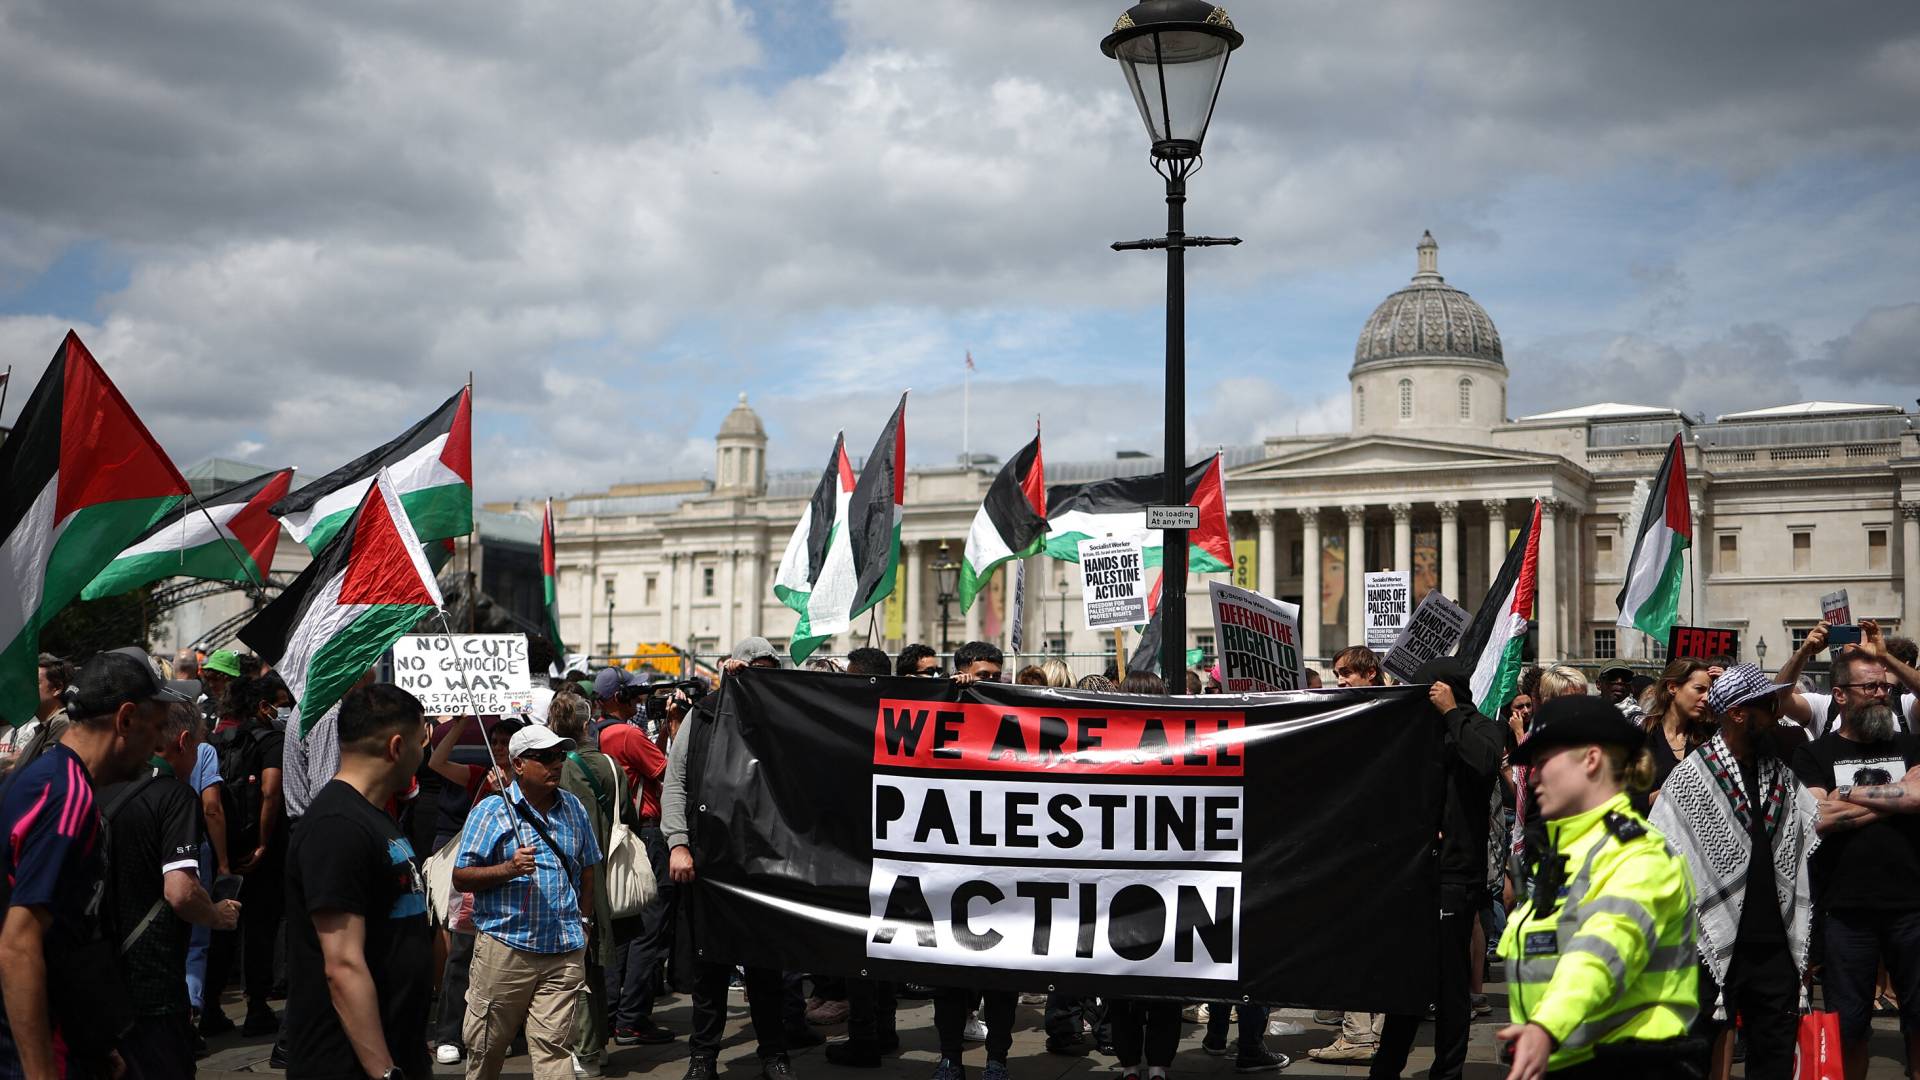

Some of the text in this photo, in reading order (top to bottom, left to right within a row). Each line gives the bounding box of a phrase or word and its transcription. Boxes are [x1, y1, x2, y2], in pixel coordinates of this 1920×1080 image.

[1166, 510, 1194, 518] loading
[1089, 543, 1111, 551] Socialist
[1084, 554, 1138, 573] HANDS OFF
[1086, 568, 1140, 587] PALESTINE
[1096, 583, 1134, 600] ACTION
[1368, 589, 1406, 602] HANDS OFF
[1088, 602, 1113, 610] FREEDOM
[1368, 602, 1406, 614] PALESTINE
[1218, 602, 1294, 646] DEFEND THE
[1374, 614, 1400, 626] ACTION
[1416, 608, 1446, 634] HANDS
[1442, 626, 1460, 644] OFF
[1408, 620, 1452, 656] PALESTINE
[416, 638, 526, 660] NO CUTS
[1222, 624, 1298, 671] RIGHT TO
[1404, 638, 1437, 662] ACTION
[397, 656, 519, 674] NO GENOCIDE
[1225, 651, 1300, 694] PROTEST
[402, 674, 510, 690] NO WAR
[1228, 679, 1252, 692] DROP
[432, 693, 498, 703] STARMER
[444, 704, 468, 714] GOT
[472, 705, 486, 713] TO
[489, 704, 506, 712] GO
[882, 707, 1241, 767] WE ARE ALL
[875, 785, 1240, 851] PALESTINE
[872, 874, 1235, 964] ACTION
